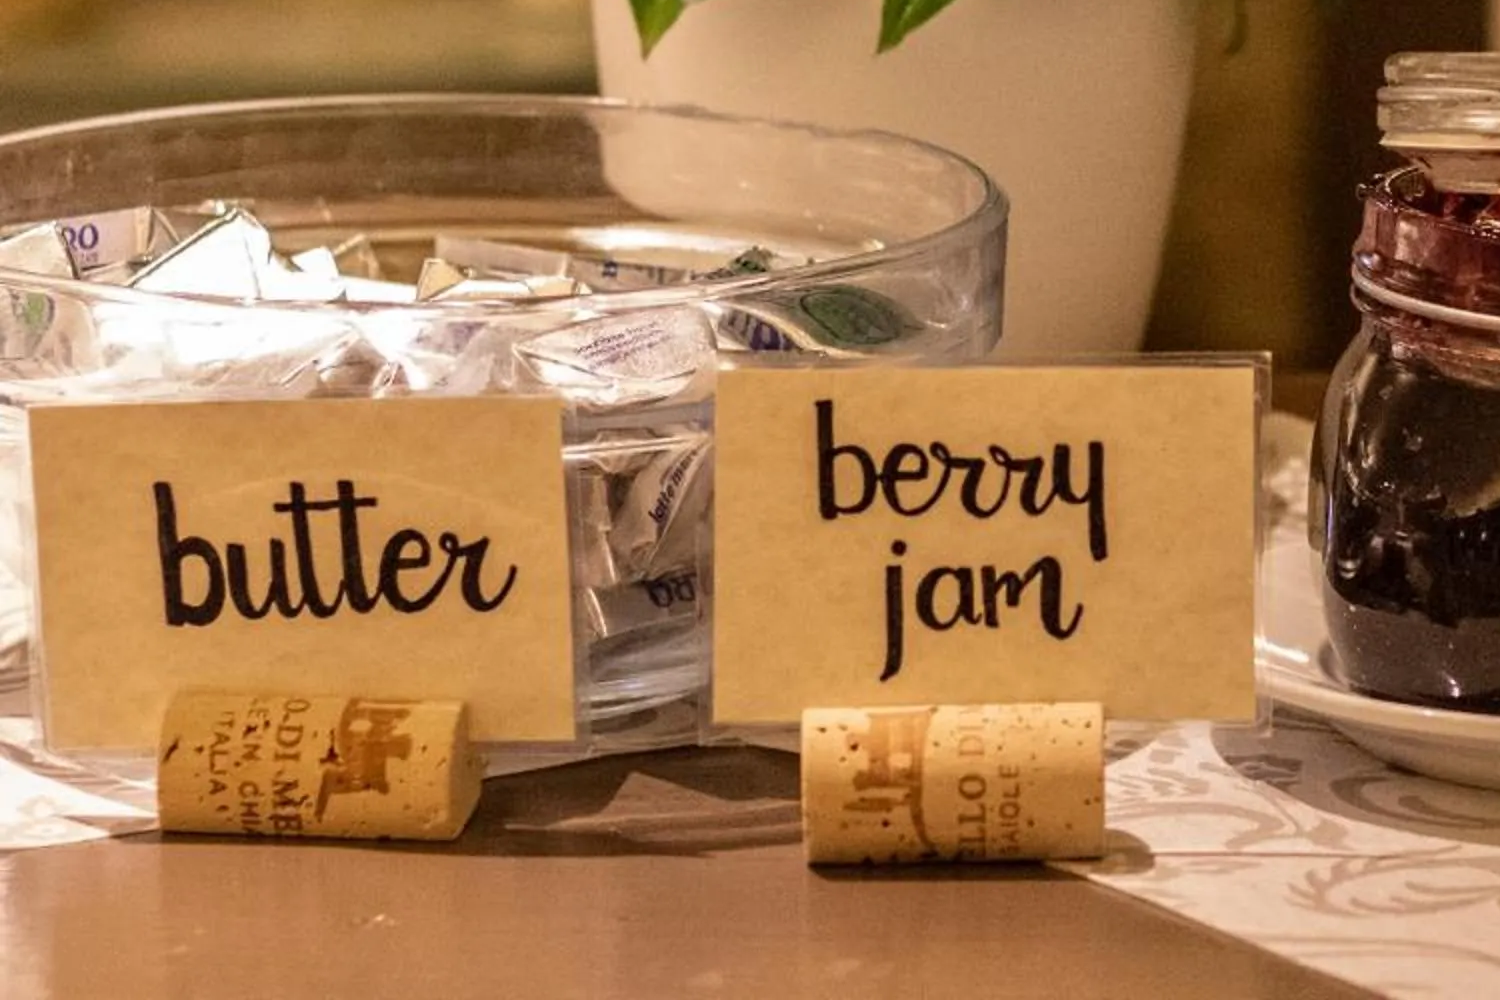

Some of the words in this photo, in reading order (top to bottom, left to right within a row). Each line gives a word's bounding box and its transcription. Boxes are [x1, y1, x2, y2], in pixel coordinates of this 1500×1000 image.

[154, 480, 517, 627] butter
[815, 400, 1107, 560] berry
[879, 540, 1083, 682] jam
